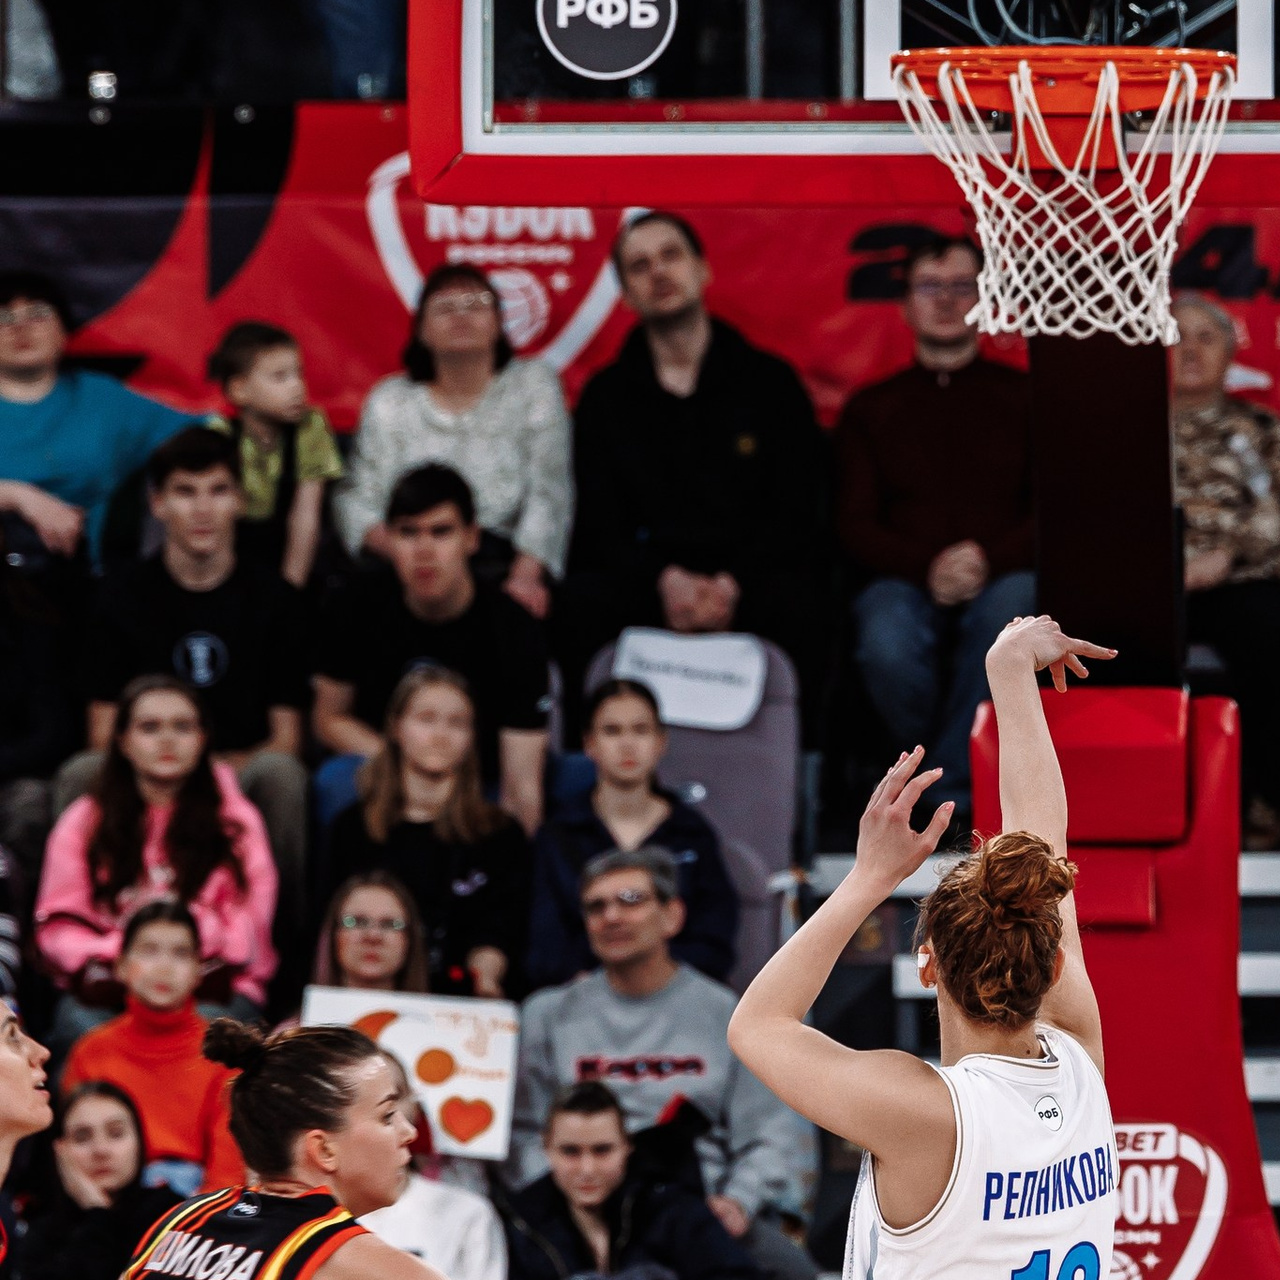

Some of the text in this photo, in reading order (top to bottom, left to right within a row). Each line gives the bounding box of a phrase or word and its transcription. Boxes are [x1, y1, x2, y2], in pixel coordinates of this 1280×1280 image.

[1038, 1107, 1059, 1121] РФБ
[1117, 1132, 1166, 1152] BET
[983, 1142, 1115, 1222] РЕПНИКОВА
